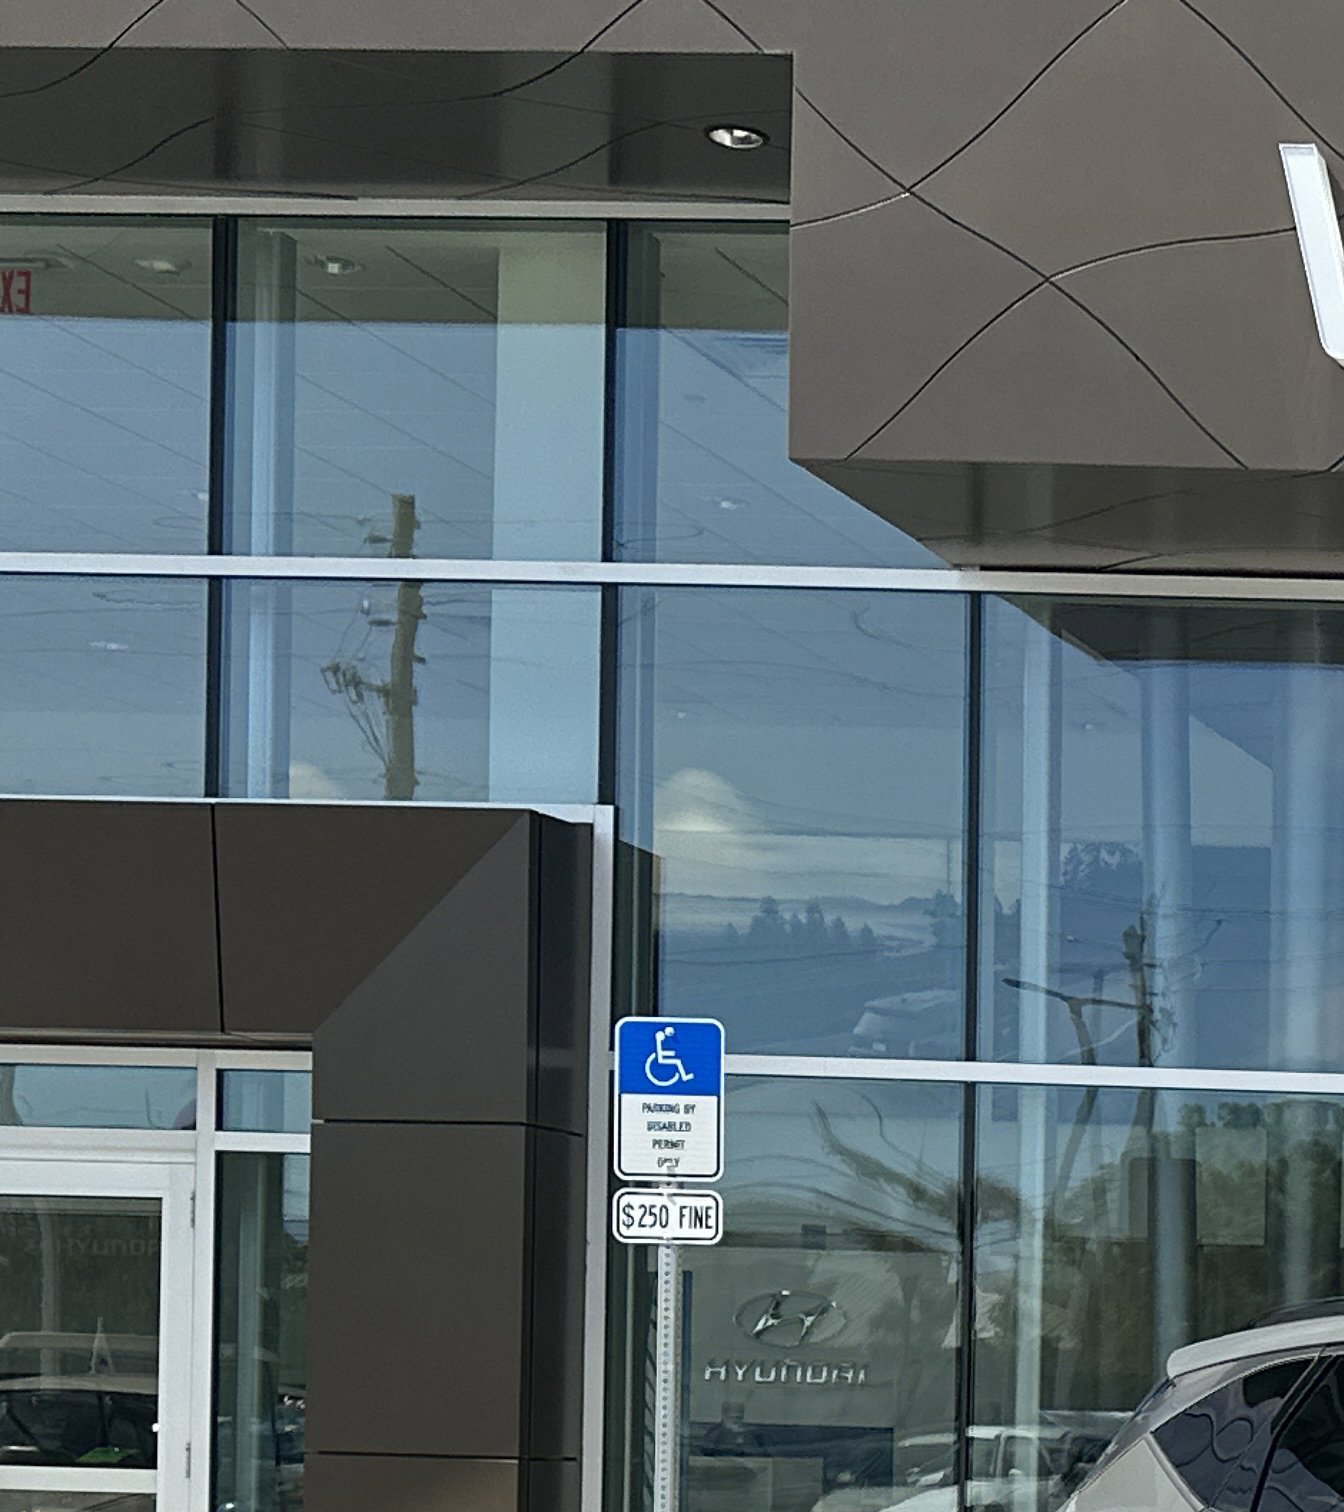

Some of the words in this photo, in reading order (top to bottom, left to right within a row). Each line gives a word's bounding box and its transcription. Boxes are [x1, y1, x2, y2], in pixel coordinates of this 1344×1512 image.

[622, 1202, 668, 1230] $250
[680, 1205, 713, 1229] FINE
[703, 1360, 867, 1384] HYUNDAI
